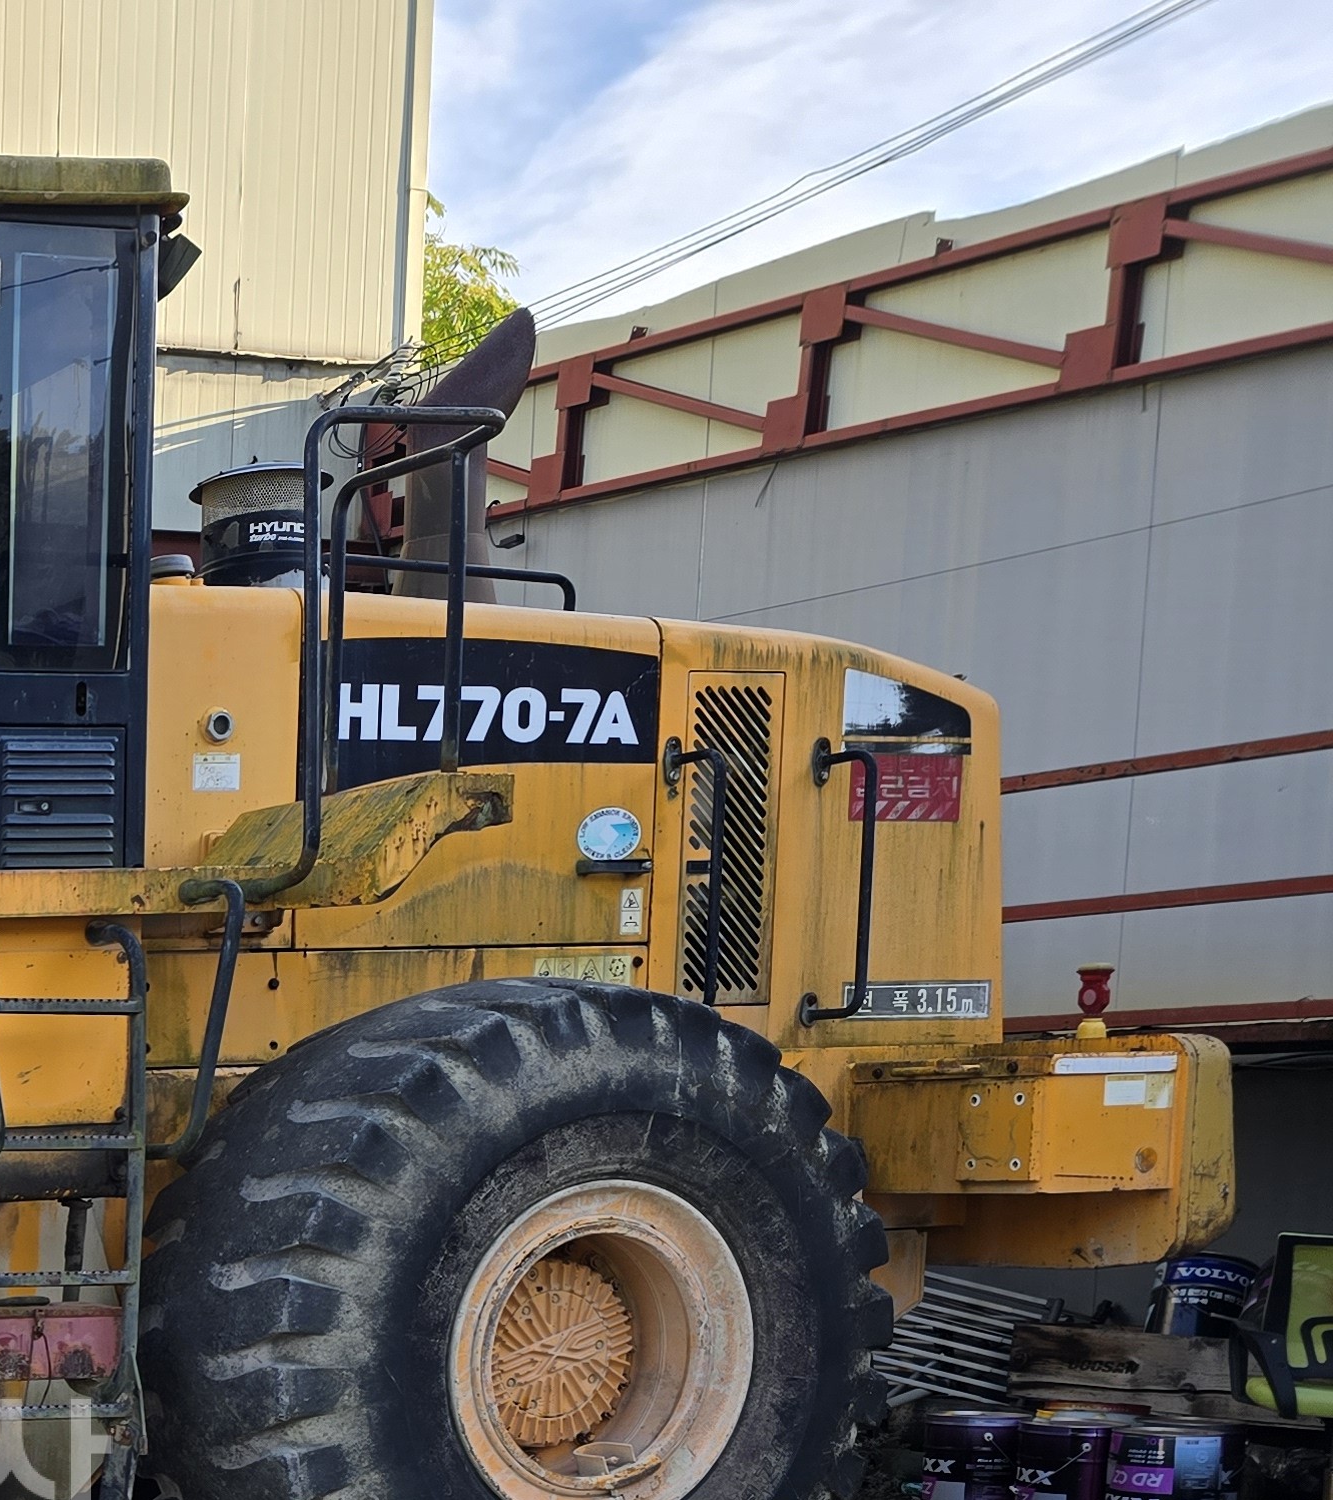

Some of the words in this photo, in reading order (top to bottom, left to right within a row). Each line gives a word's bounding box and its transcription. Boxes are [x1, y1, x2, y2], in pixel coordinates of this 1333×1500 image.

[249, 520, 305, 534] HYUND
[337, 682, 640, 745] HL770-7A
[891, 989, 910, 1012] 폭
[1176, 1267, 1251, 1288] VOLVO
